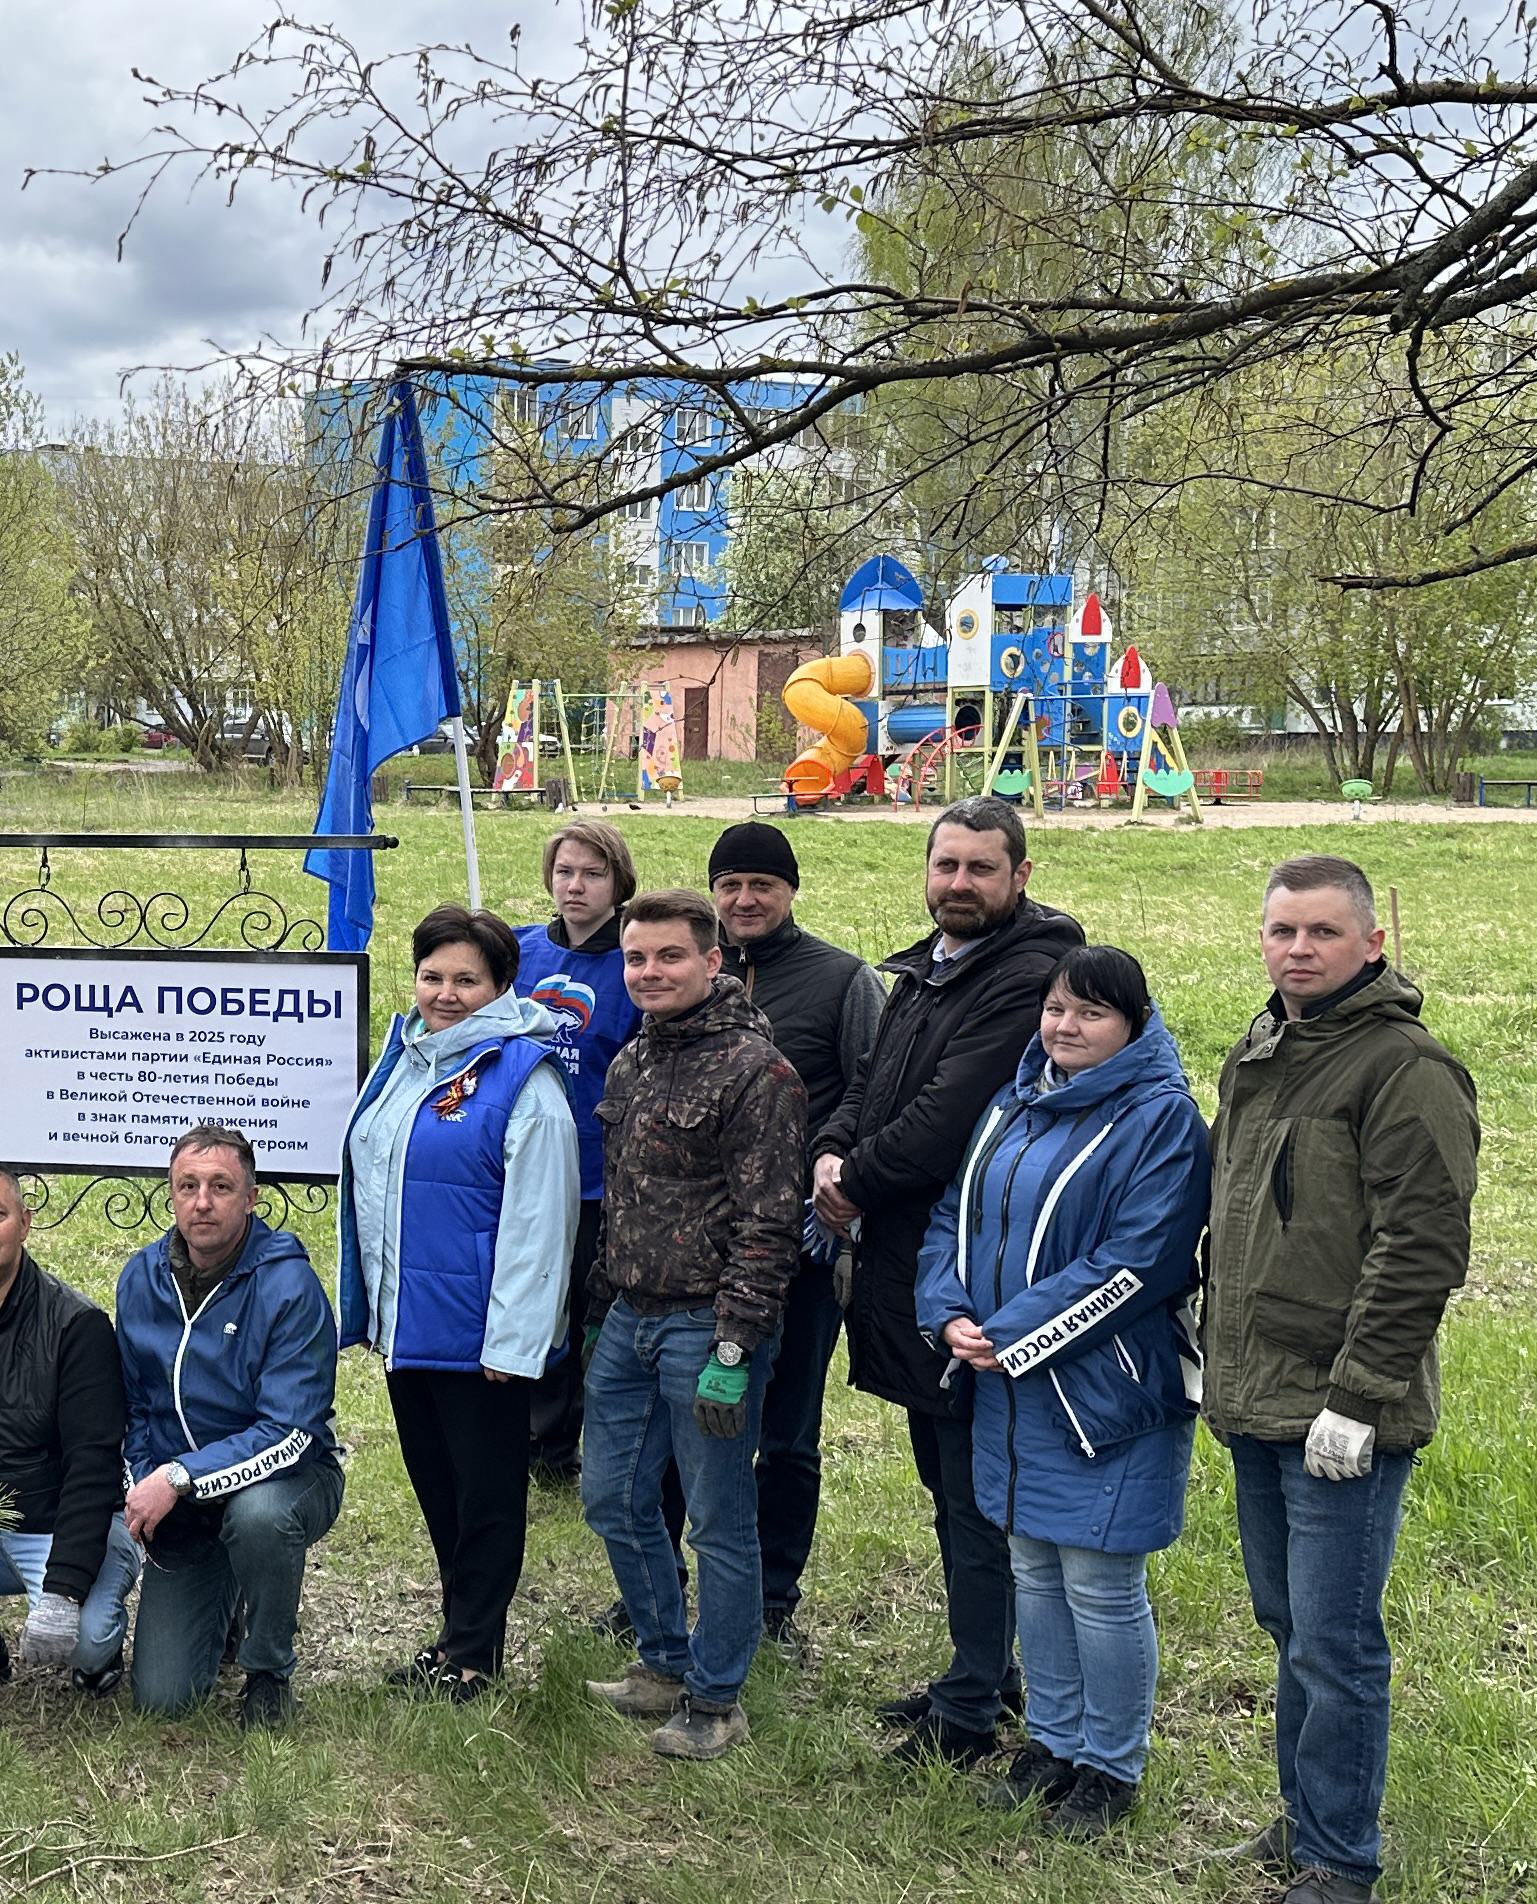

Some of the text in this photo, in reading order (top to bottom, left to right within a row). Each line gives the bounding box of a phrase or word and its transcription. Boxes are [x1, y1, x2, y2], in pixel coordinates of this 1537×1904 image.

[16, 982, 342, 1023] РОЩА ПОБЕДЫ
[89, 1027, 267, 1047] Высажена в 2025 году
[24, 1048, 333, 1068] активистами партии «Единая Россия»
[76, 1070, 279, 1088] в честь 80-летия Победы
[46, 1088, 311, 1109] в Великой Отечественной войне
[77, 1112, 278, 1129] в знак памяти, уважения
[48, 1131, 58, 1142] и
[62, 1130, 119, 1144] вечной
[1004, 1276, 1135, 1371] ЕДИНАЯ РОССИ
[199, 1462, 262, 1497] РОССИЯ
